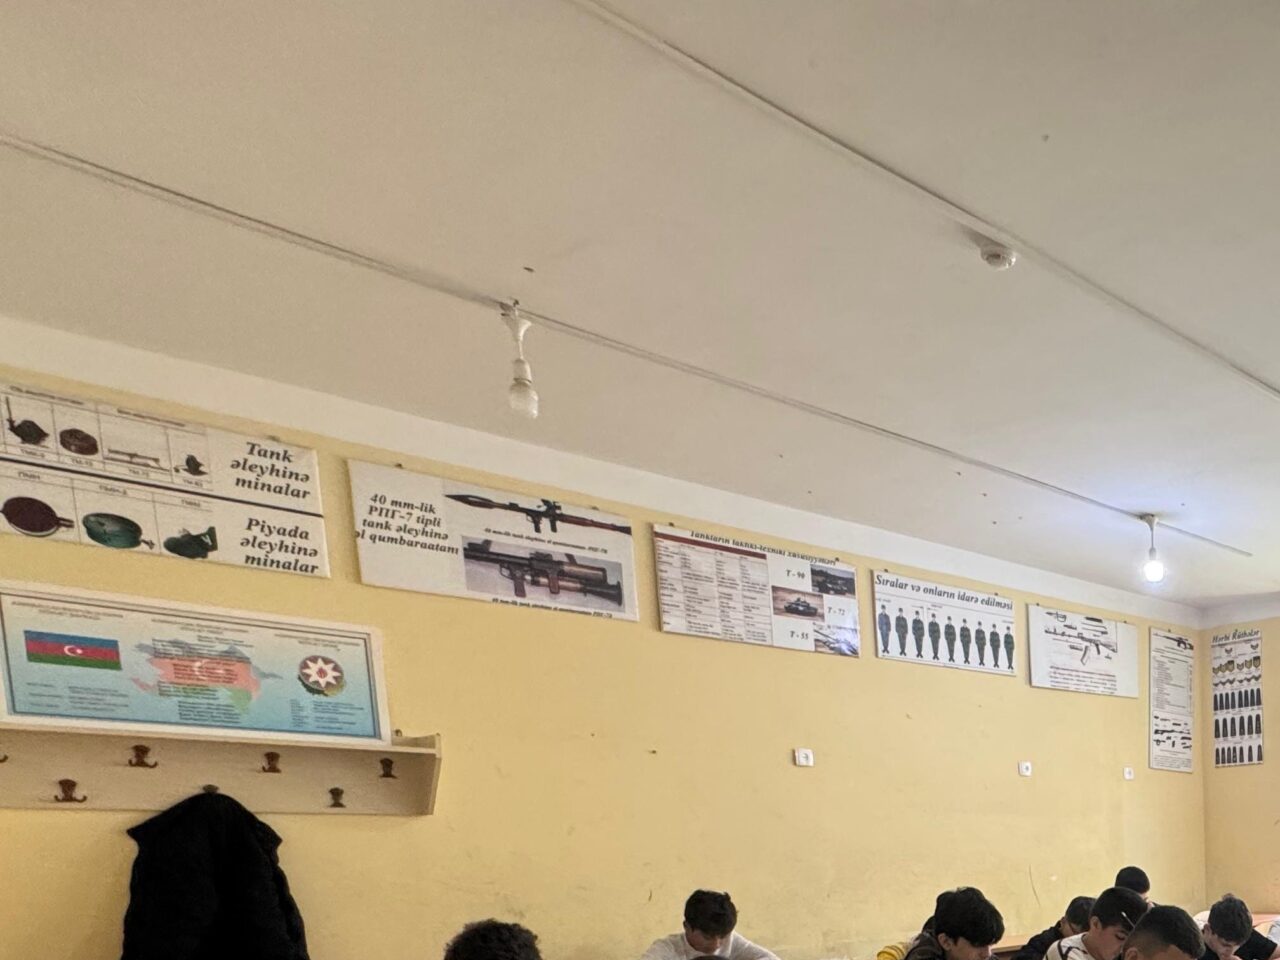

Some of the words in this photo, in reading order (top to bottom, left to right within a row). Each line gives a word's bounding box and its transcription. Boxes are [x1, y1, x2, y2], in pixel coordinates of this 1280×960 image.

[246, 441, 294, 463] Tank
[230, 458, 310, 483] əleyhinə
[235, 476, 311, 499] minalar
[370, 493, 387, 505] 40
[390, 499, 437, 514] mm-lik
[245, 517, 310, 540] Piyada
[362, 518, 392, 531] tank
[396, 524, 449, 540] əleyhinə
[416, 515, 442, 528] tipli
[240, 535, 319, 558] əleyhinə
[369, 533, 460, 555] qumbaraatanı
[244, 554, 319, 574] minalar
[875, 574, 909, 591] Sıralar
[911, 584, 921, 592] və
[923, 585, 955, 599] onların
[957, 592, 979, 604] idarə
[980, 597, 1013, 611] edilməsi
